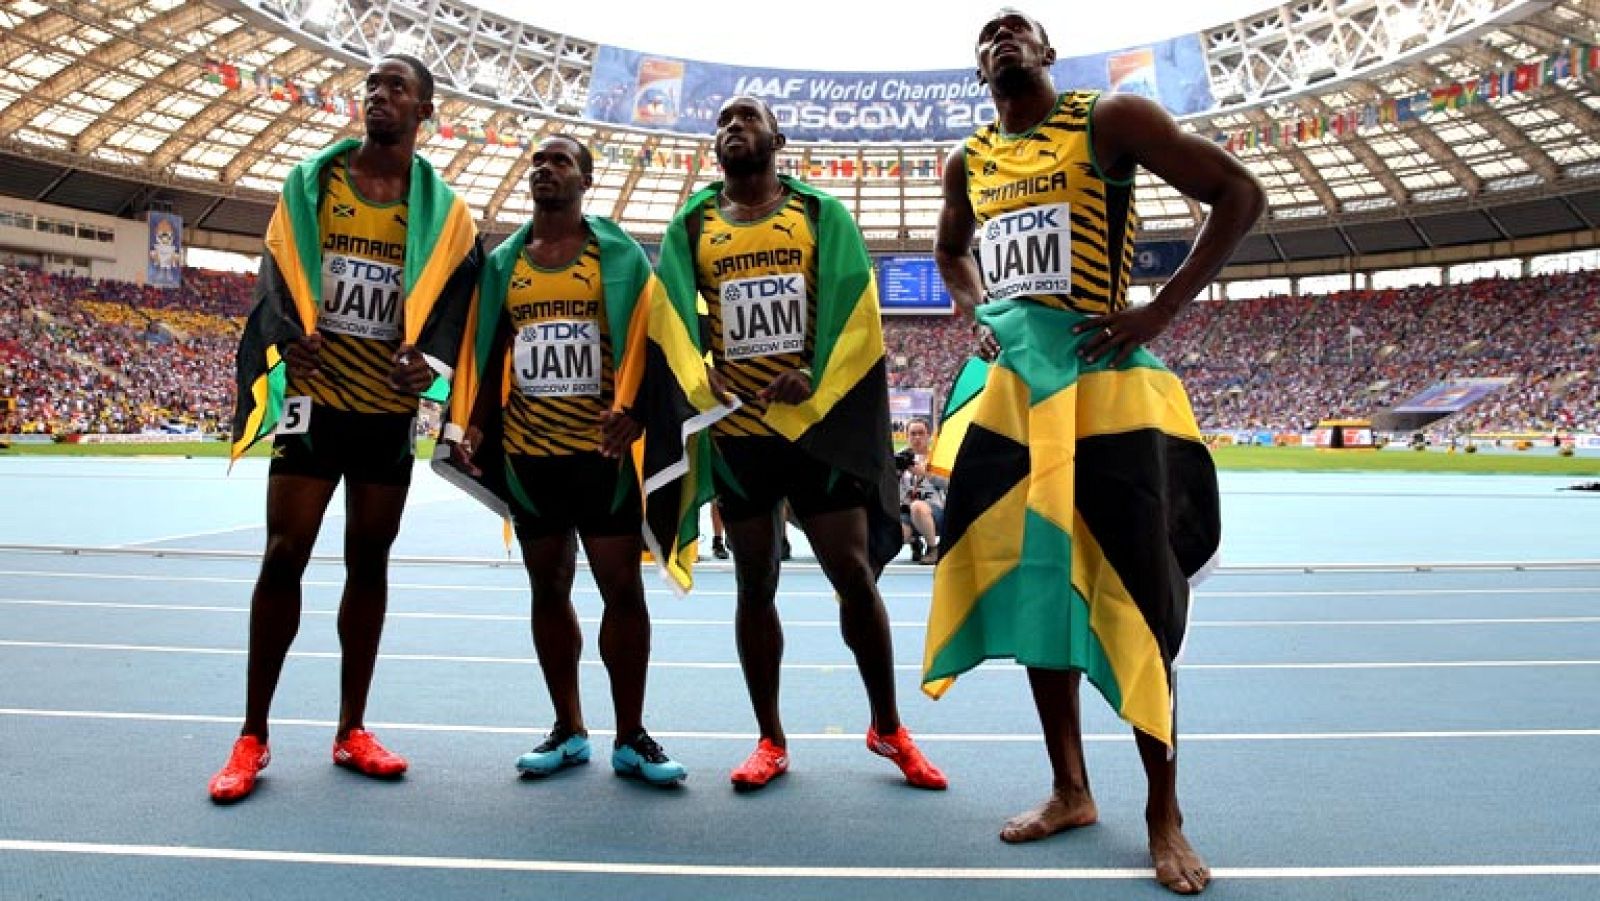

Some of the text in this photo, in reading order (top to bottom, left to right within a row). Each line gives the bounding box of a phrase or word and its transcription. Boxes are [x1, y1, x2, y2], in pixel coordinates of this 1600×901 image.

[735, 76, 804, 99] IAAF
[810, 79, 877, 100] World
[775, 105, 933, 129] OSCOW
[977, 171, 1067, 203] JAMAICA
[1000, 208, 1059, 236] TDK
[322, 233, 407, 260] JAMAIC
[988, 233, 1061, 284] JAM
[347, 259, 402, 287] TDK
[711, 248, 803, 278] JAMAICA
[739, 276, 798, 300] TDK
[1034, 278, 1068, 291] 2013
[324, 280, 400, 324] JAM
[511, 300, 599, 321] JAMAICA
[537, 322, 591, 342] TDK
[729, 300, 803, 341] JAM
[522, 345, 593, 380] JAM
[727, 342, 779, 356] MOSCOW
[285, 402, 301, 428] 5
